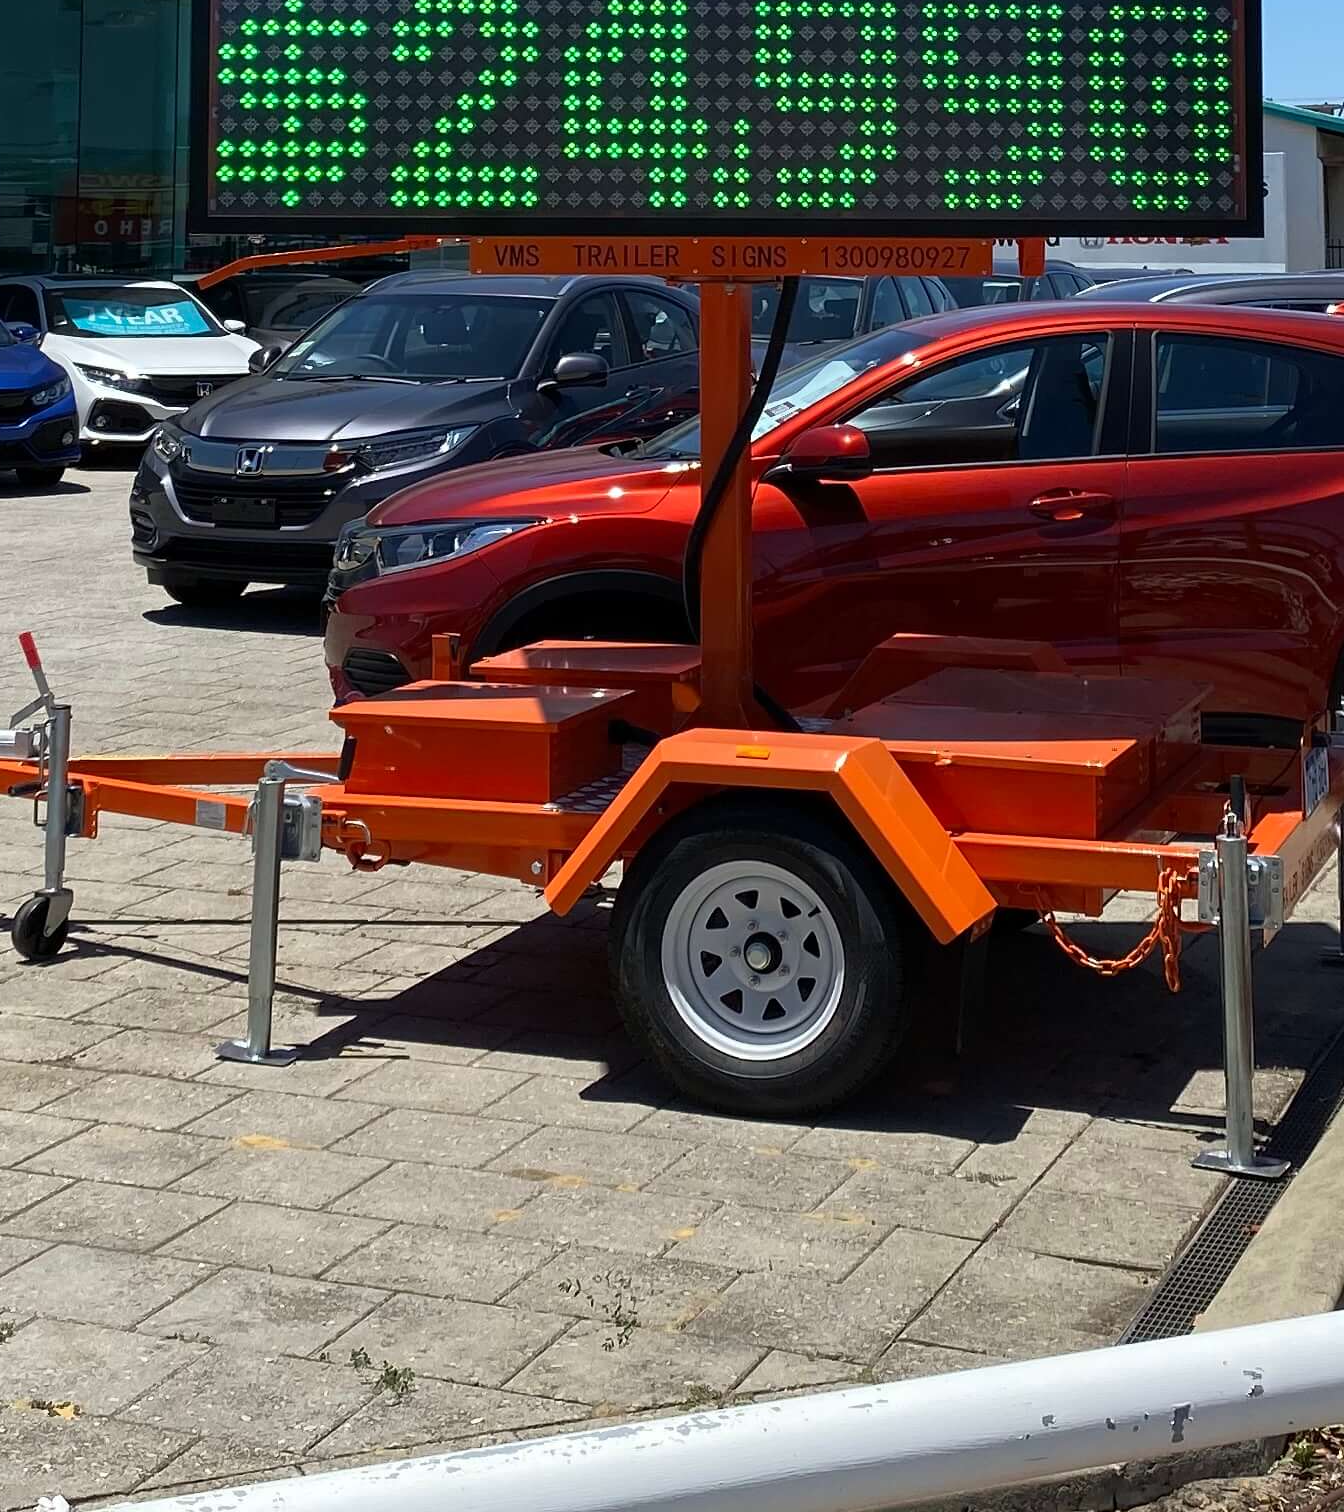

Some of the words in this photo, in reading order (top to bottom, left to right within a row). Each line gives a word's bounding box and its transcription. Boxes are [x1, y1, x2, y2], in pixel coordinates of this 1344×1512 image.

[495, 245, 539, 267] VMS
[574, 245, 680, 267] TRAILER
[712, 246, 787, 268] SIGNS
[820, 246, 971, 270] 1300980927
